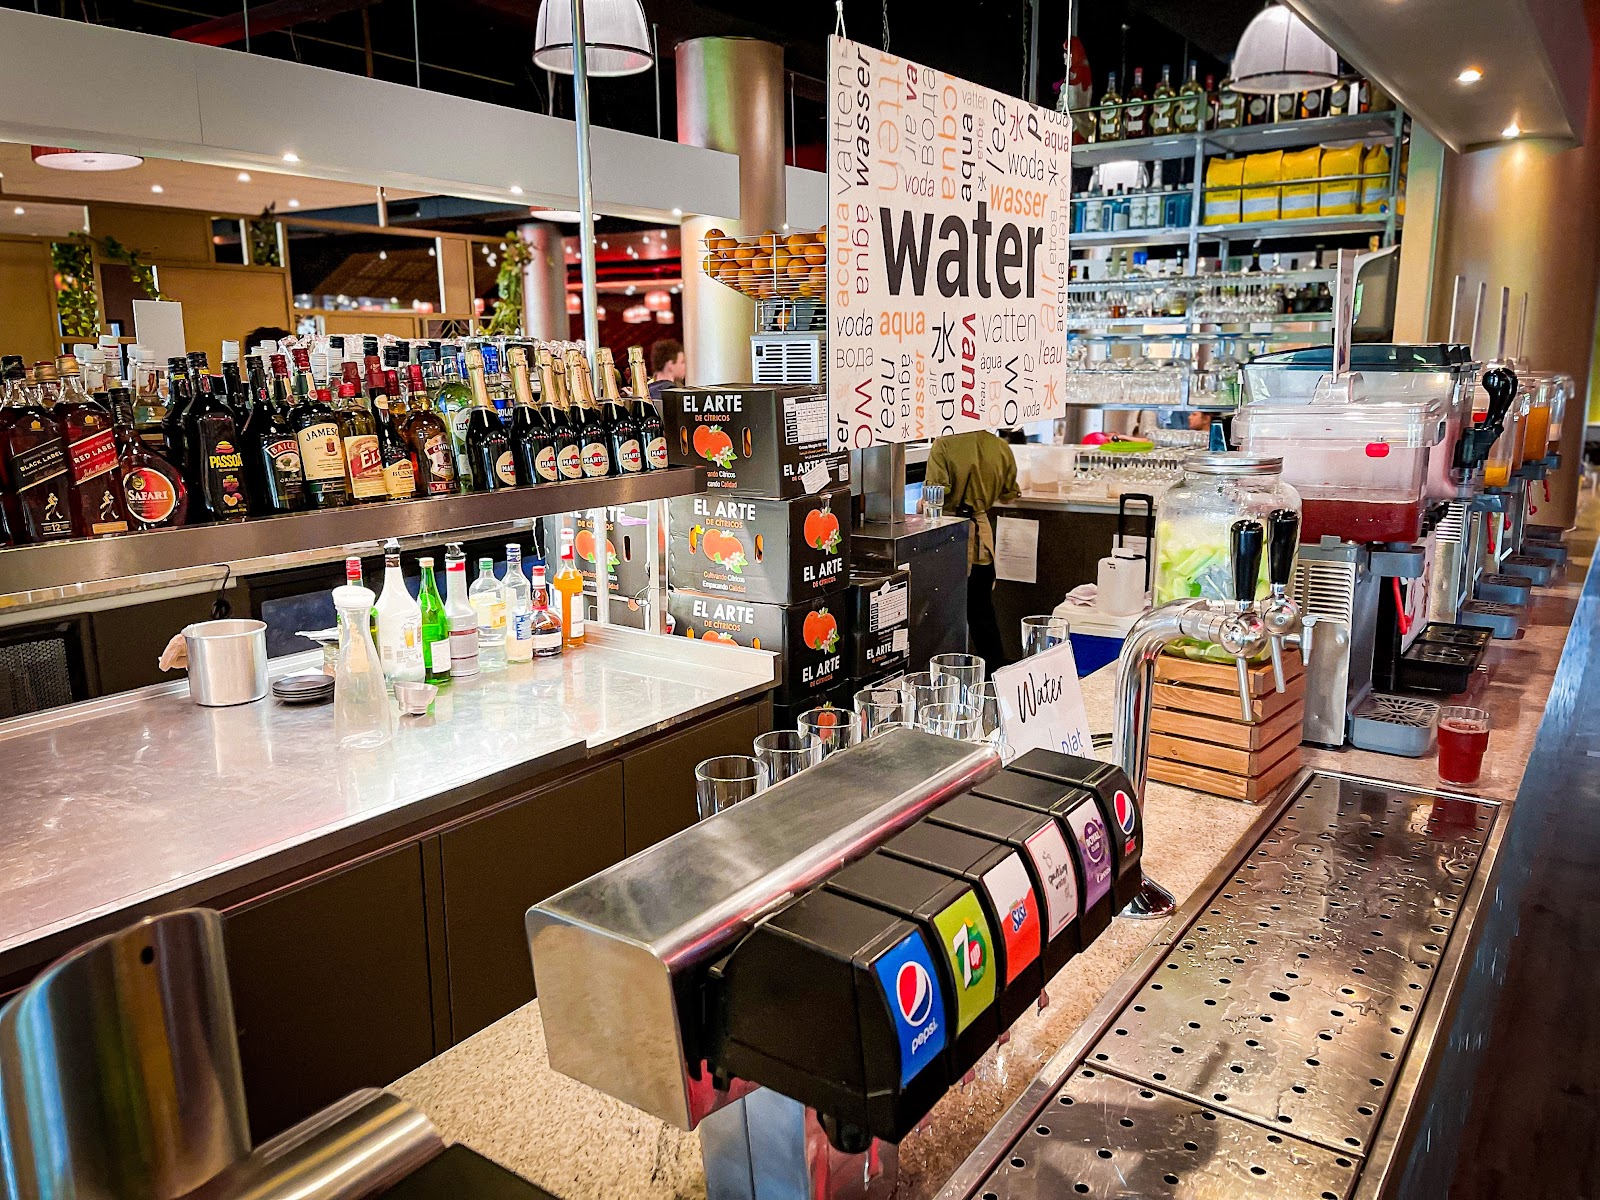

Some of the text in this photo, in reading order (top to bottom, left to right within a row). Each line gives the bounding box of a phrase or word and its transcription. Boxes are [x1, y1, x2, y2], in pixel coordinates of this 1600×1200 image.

[961, 89, 988, 111] vatten
[834, 63, 852, 196] vatten
[856, 47, 871, 187] wasser
[1009, 105, 1024, 142] 水
[904, 114, 917, 161] air
[1044, 128, 1069, 155] aqua
[961, 113, 976, 202] aqua
[1007, 149, 1044, 182] woda
[904, 171, 935, 198] voda
[978, 171, 987, 192] 水
[1047, 158, 1057, 187] 水
[990, 183, 1049, 219] wasser
[836, 202, 853, 308] acqua
[852, 203, 874, 295] água
[879, 201, 1044, 299] water
[1041, 261, 1056, 334] air
[1057, 262, 1065, 332] acqua
[836, 308, 873, 337] voda
[879, 310, 926, 343] aqua
[981, 307, 1037, 343] vatten
[931, 311, 956, 364] 水
[961, 312, 981, 421] vand
[980, 352, 1002, 375] água
[1038, 339, 1063, 366] l'eau
[899, 353, 914, 418] água
[927, 368, 938, 397] air
[1023, 353, 1038, 399] air
[683, 394, 742, 412] EL ARTE
[875, 357, 896, 444] l'eau
[915, 350, 926, 440] wasser
[1043, 374, 1058, 411] 水
[694, 414, 703, 422] DE
[1022, 400, 1040, 418] voda
[901, 424, 910, 439] 水
[20, 458, 43, 472] BLACK
[42, 450, 64, 463] LABEL
[73, 452, 91, 464] RED
[92, 442, 116, 456] LABEL
[783, 464, 795, 477] EL
[128, 489, 168, 501] SAFARI
[693, 498, 756, 521] EL ARTE
[51, 523, 62, 532] 12
[585, 506, 626, 523] ATE
[705, 518, 714, 526] DE
[803, 557, 843, 582] EL ARTE
[812, 580, 818, 588] DE
[692, 599, 754, 625] EL ARTE
[703, 619, 713, 628] DE
[866, 647, 875, 660] EL
[875, 641, 892, 657] ARTE
[802, 654, 840, 683] EL ARTE
[809, 680, 815, 688] DE
[1017, 672, 1063, 724] Water
[911, 1016, 937, 1056] pepsi
